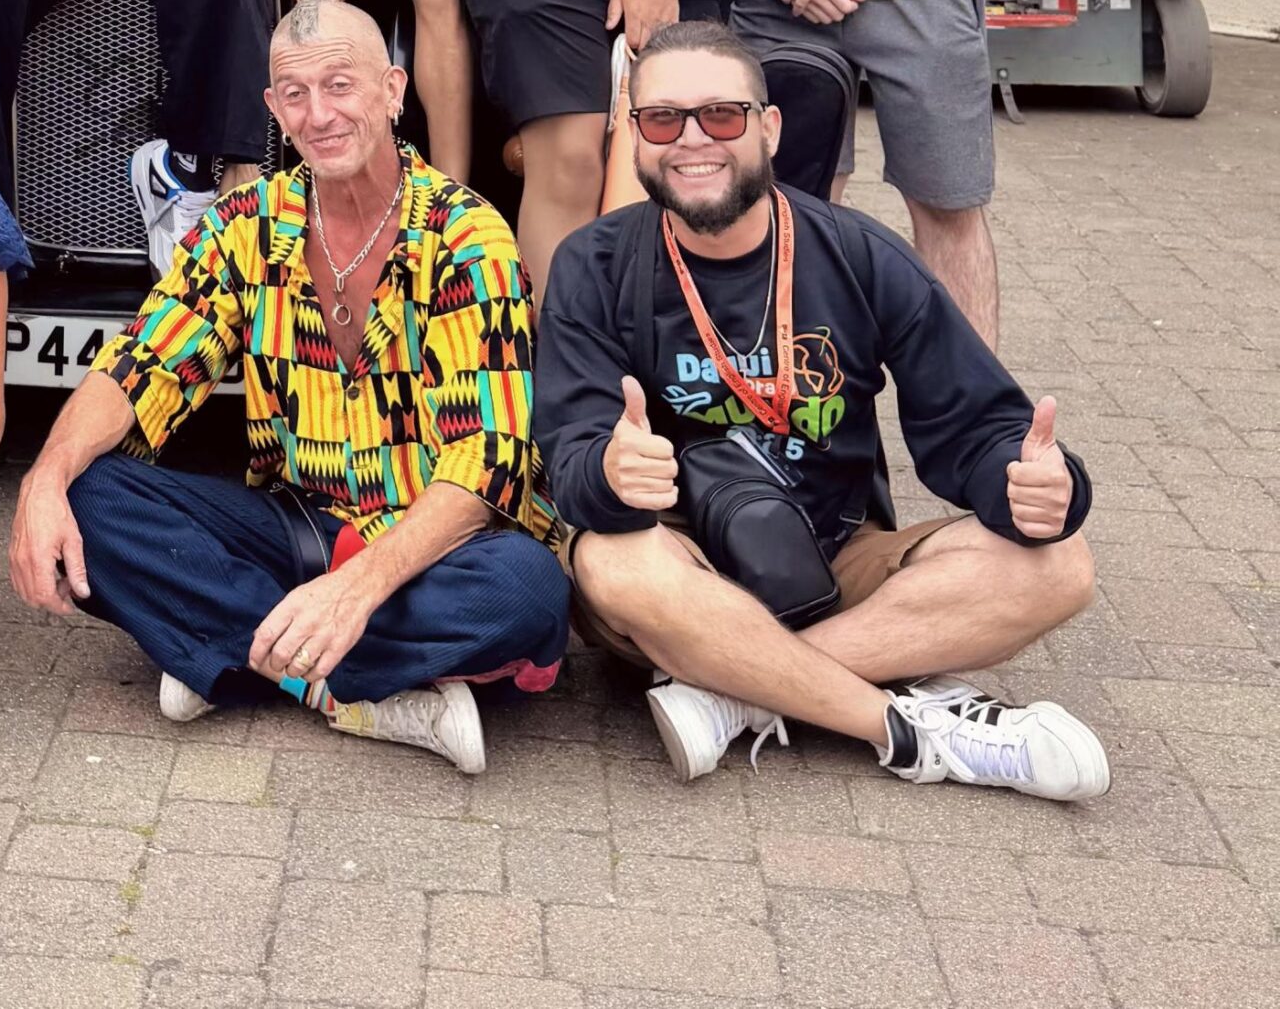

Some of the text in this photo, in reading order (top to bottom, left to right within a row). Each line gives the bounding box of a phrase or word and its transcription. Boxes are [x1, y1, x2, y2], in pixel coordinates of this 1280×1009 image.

[677, 347, 773, 384] Daui
[781, 345, 790, 371] Centre
[782, 373, 789, 381] of
[746, 394, 767, 416] Centre
